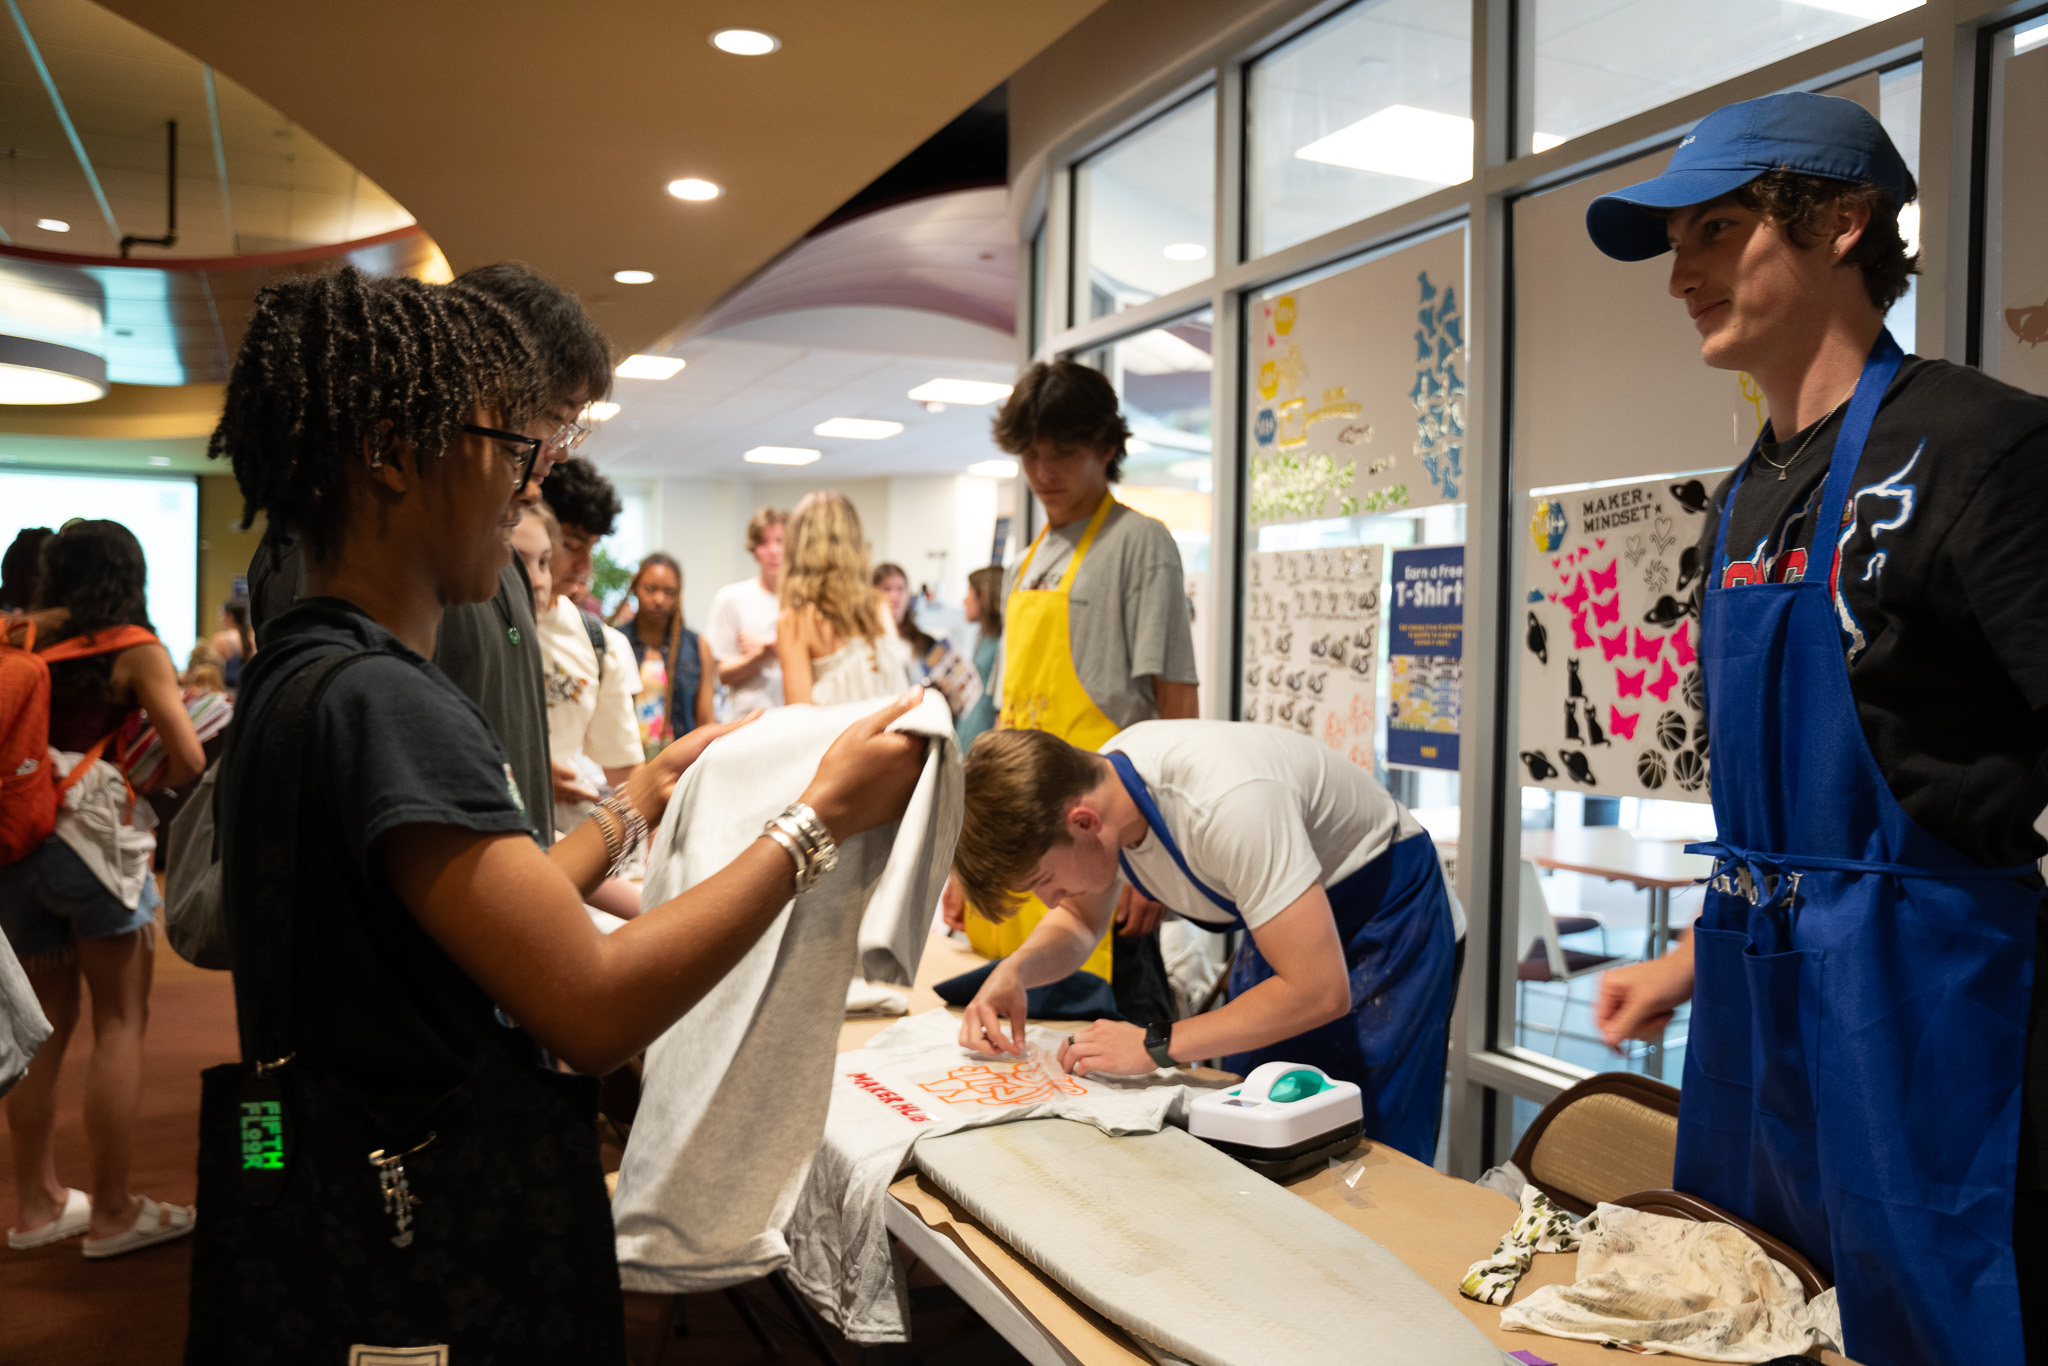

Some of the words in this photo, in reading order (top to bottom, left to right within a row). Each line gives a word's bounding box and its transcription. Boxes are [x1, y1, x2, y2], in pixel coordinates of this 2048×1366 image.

[1583, 489, 1643, 517] MAKER
[1583, 505, 1651, 534] MINDSET
[1405, 565, 1428, 580] Earn
[1430, 566, 1438, 580] a
[1395, 580, 1463, 608] T-Shirt
[846, 1072, 905, 1104] MAKER
[890, 1103, 931, 1122] HUB
[240, 1102, 263, 1169] FLOOR
[261, 1101, 284, 1169] FIFTH
